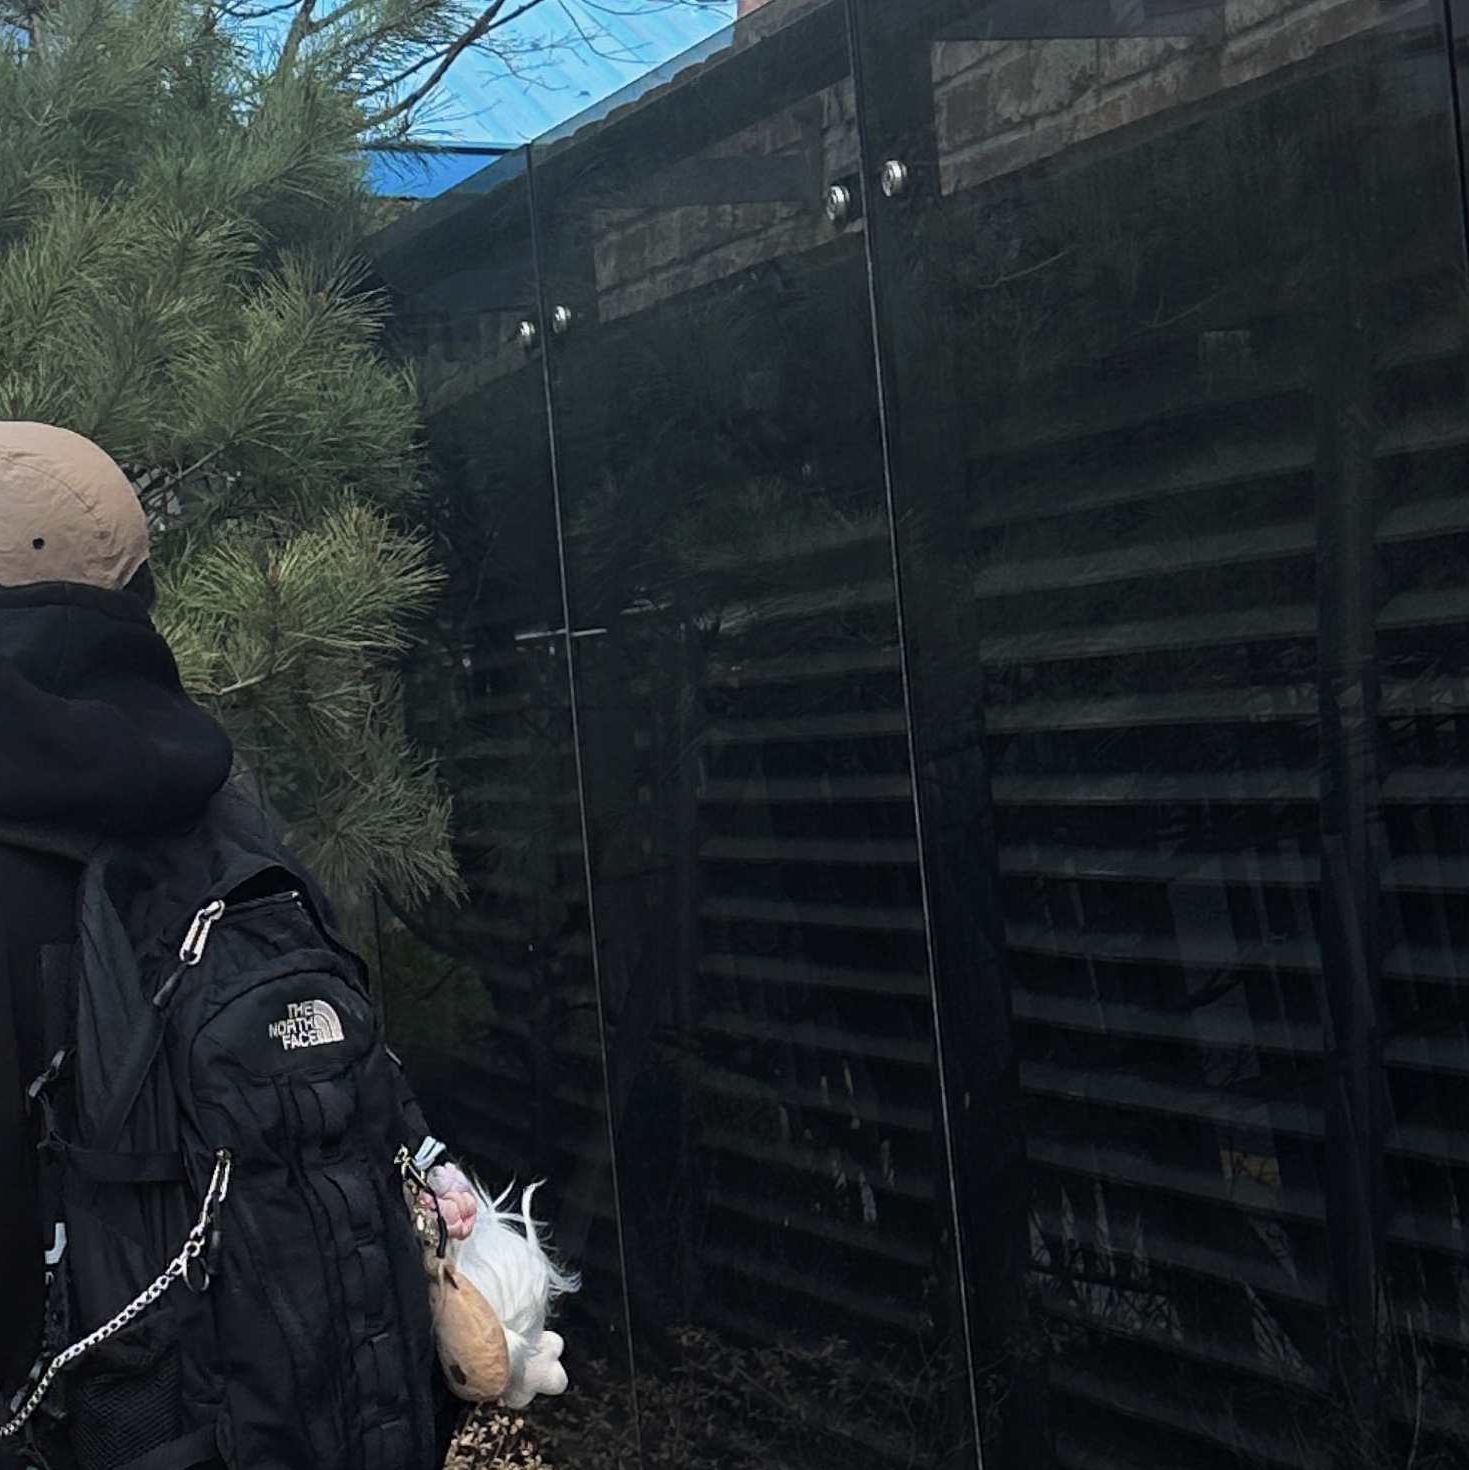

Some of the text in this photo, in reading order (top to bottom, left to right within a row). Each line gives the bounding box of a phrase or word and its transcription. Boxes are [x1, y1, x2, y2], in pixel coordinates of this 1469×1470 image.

[287, 1000, 314, 1019] THE
[268, 1016, 318, 1040] NORTH
[282, 1030, 319, 1051] FACE
